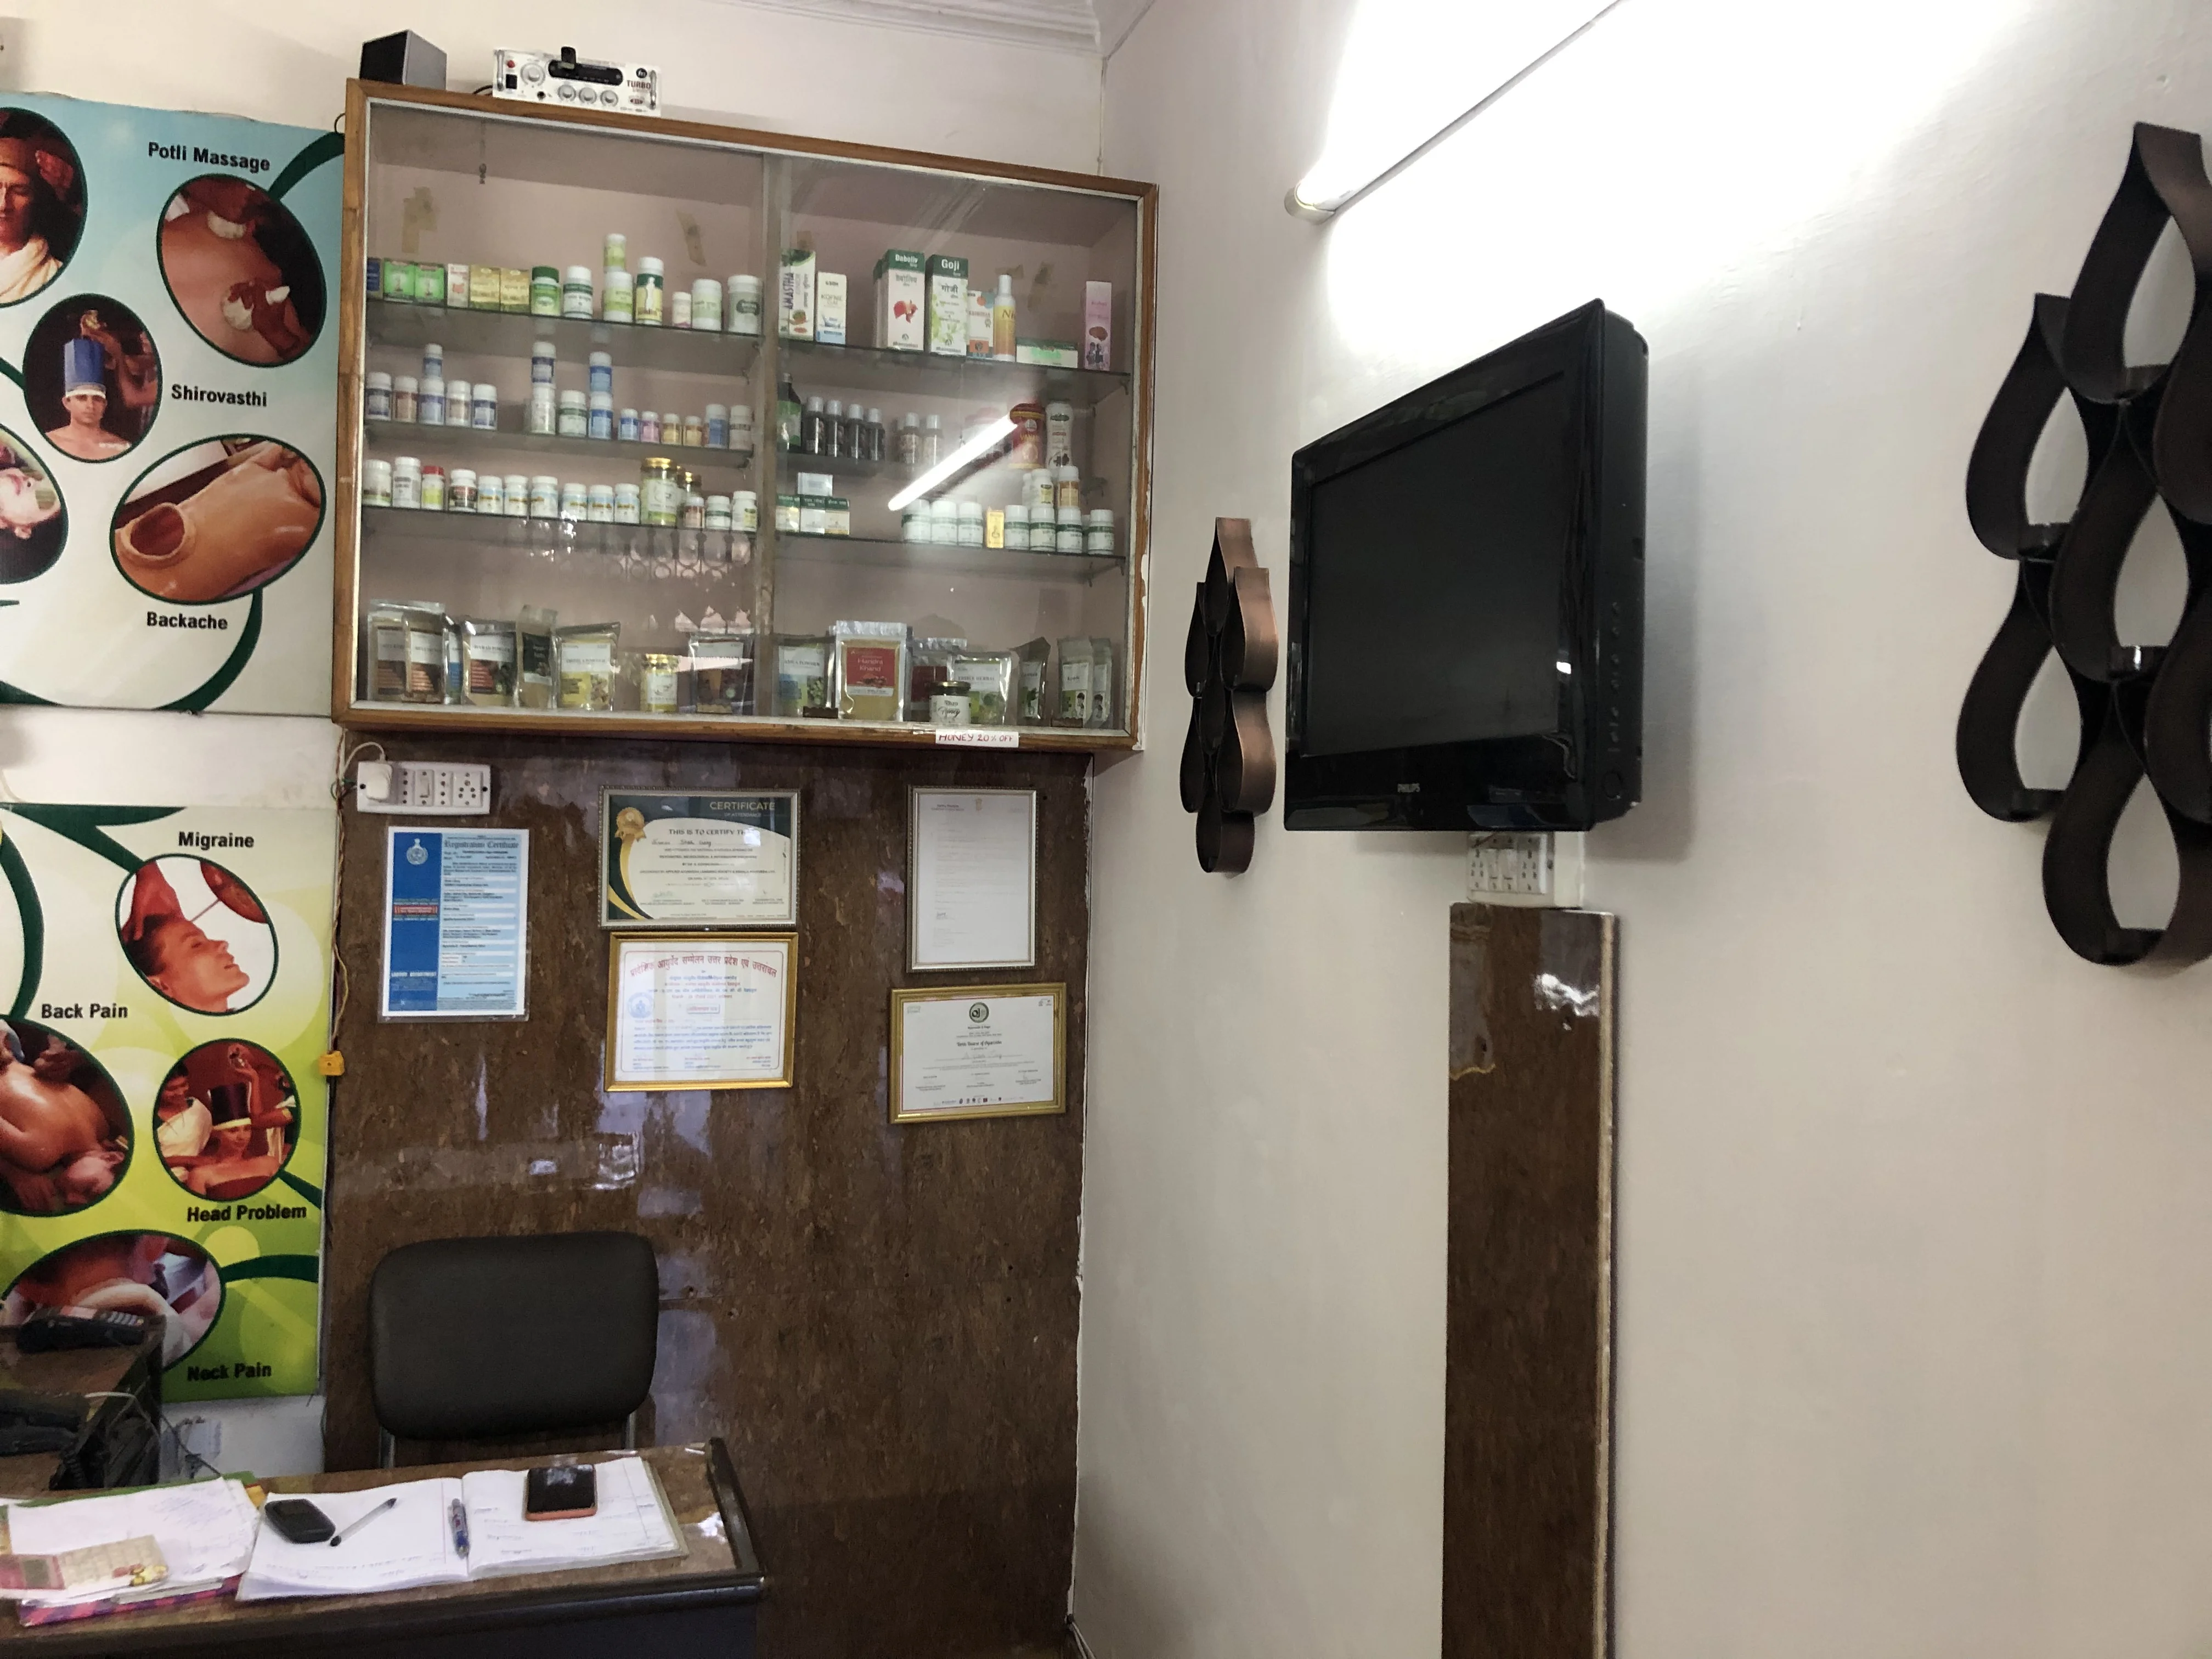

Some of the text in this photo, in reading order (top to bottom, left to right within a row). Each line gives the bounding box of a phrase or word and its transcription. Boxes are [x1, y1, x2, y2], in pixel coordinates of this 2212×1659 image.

[149, 142, 270, 174] Potli Massage
[941, 259, 960, 271] Goji
[172, 385, 267, 407] Shirovasthi
[147, 611, 228, 630] Backache
[709, 802, 775, 811] CERTIFICATE
[178, 832, 255, 851] Migraine
[41, 1003, 128, 1019] Back Pain
[187, 1204, 307, 1222] Head Problem
[187, 1363, 272, 1381] Neck Pain
